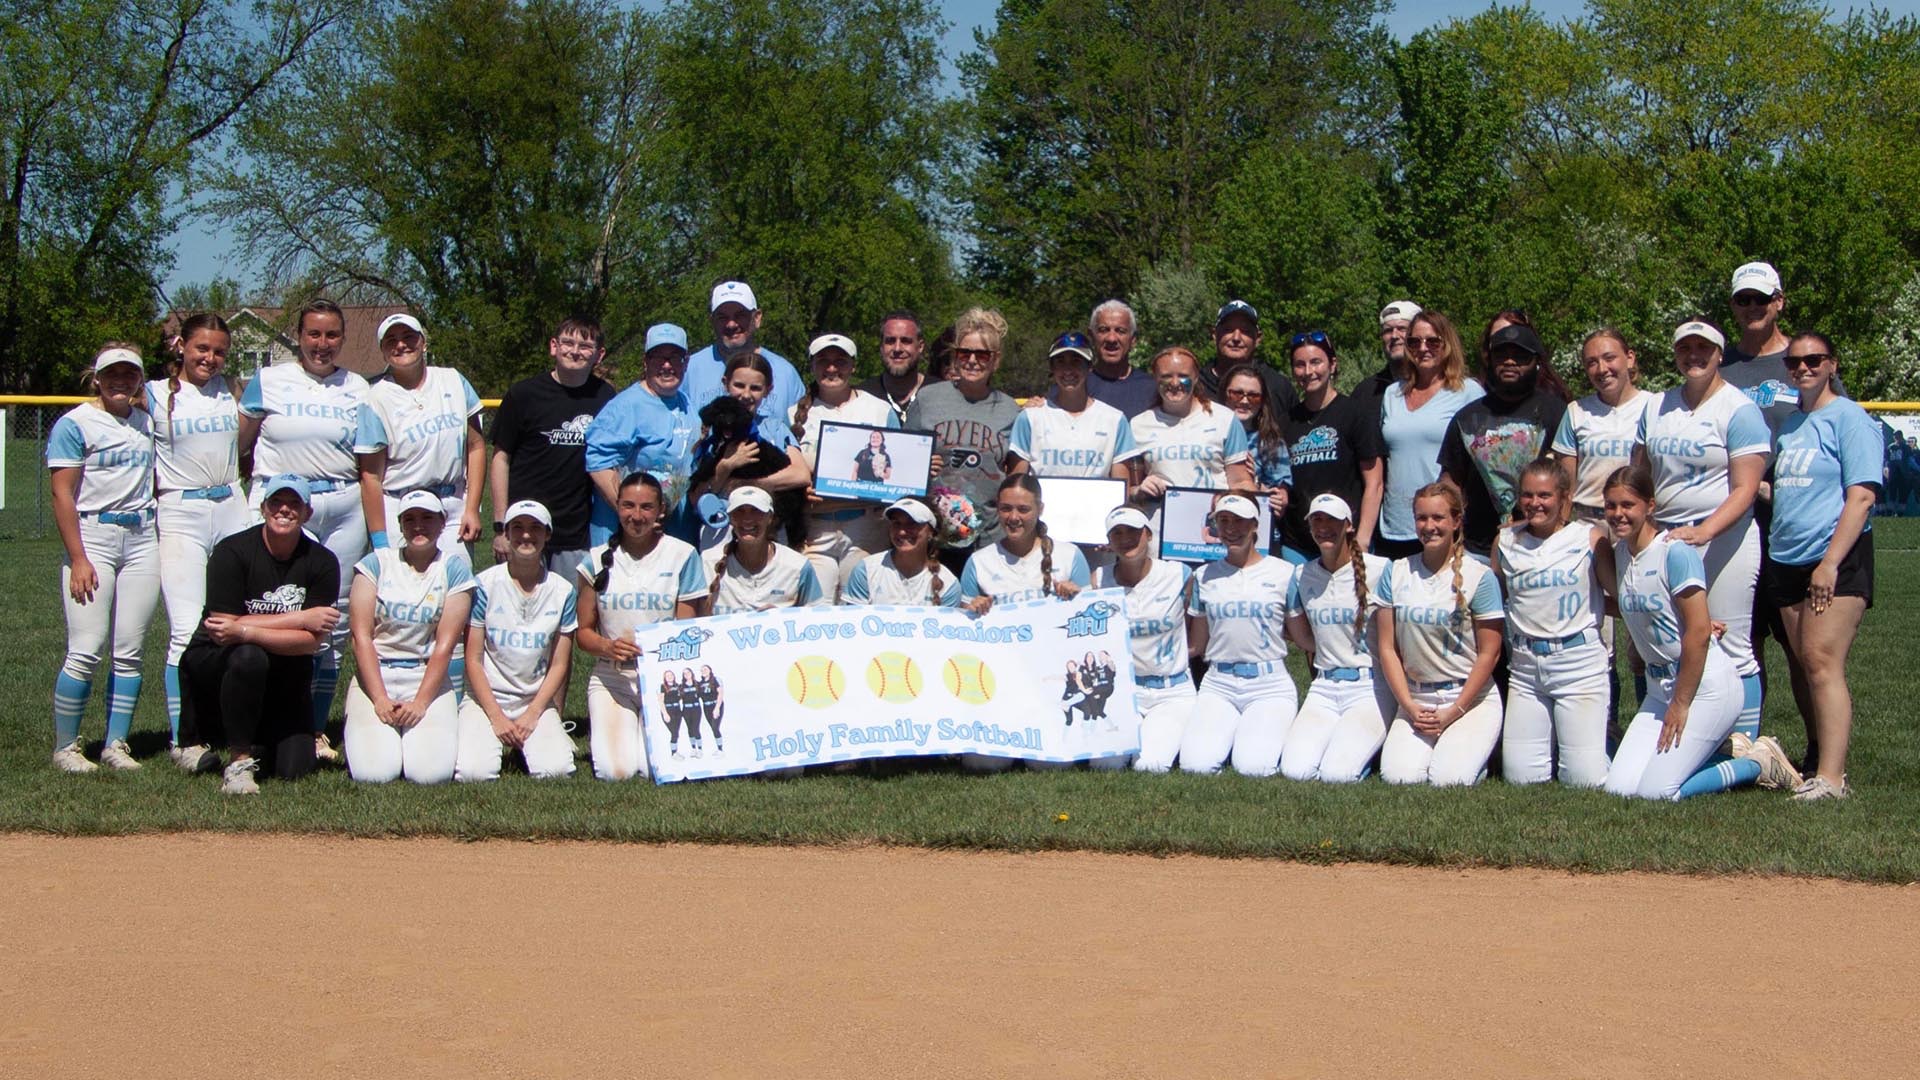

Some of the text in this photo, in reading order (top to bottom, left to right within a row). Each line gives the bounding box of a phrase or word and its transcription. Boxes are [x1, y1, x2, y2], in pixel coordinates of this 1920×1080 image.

[1040, 449, 1105, 468] TIGERS
[1147, 444, 1214, 463] TIGERS
[1581, 439, 1633, 457] TIGER
[1509, 569, 1579, 591] TIGERS
[252, 602, 303, 613] HOLY FAMIL
[600, 591, 674, 612] TIGERS
[1205, 600, 1274, 621] TIGERS
[1557, 591, 1581, 622] 10
[1307, 607, 1356, 627] TIGER
[728, 615, 1034, 650] We Love Our Seniors
[752, 718, 1044, 761] Holy Family Softball
